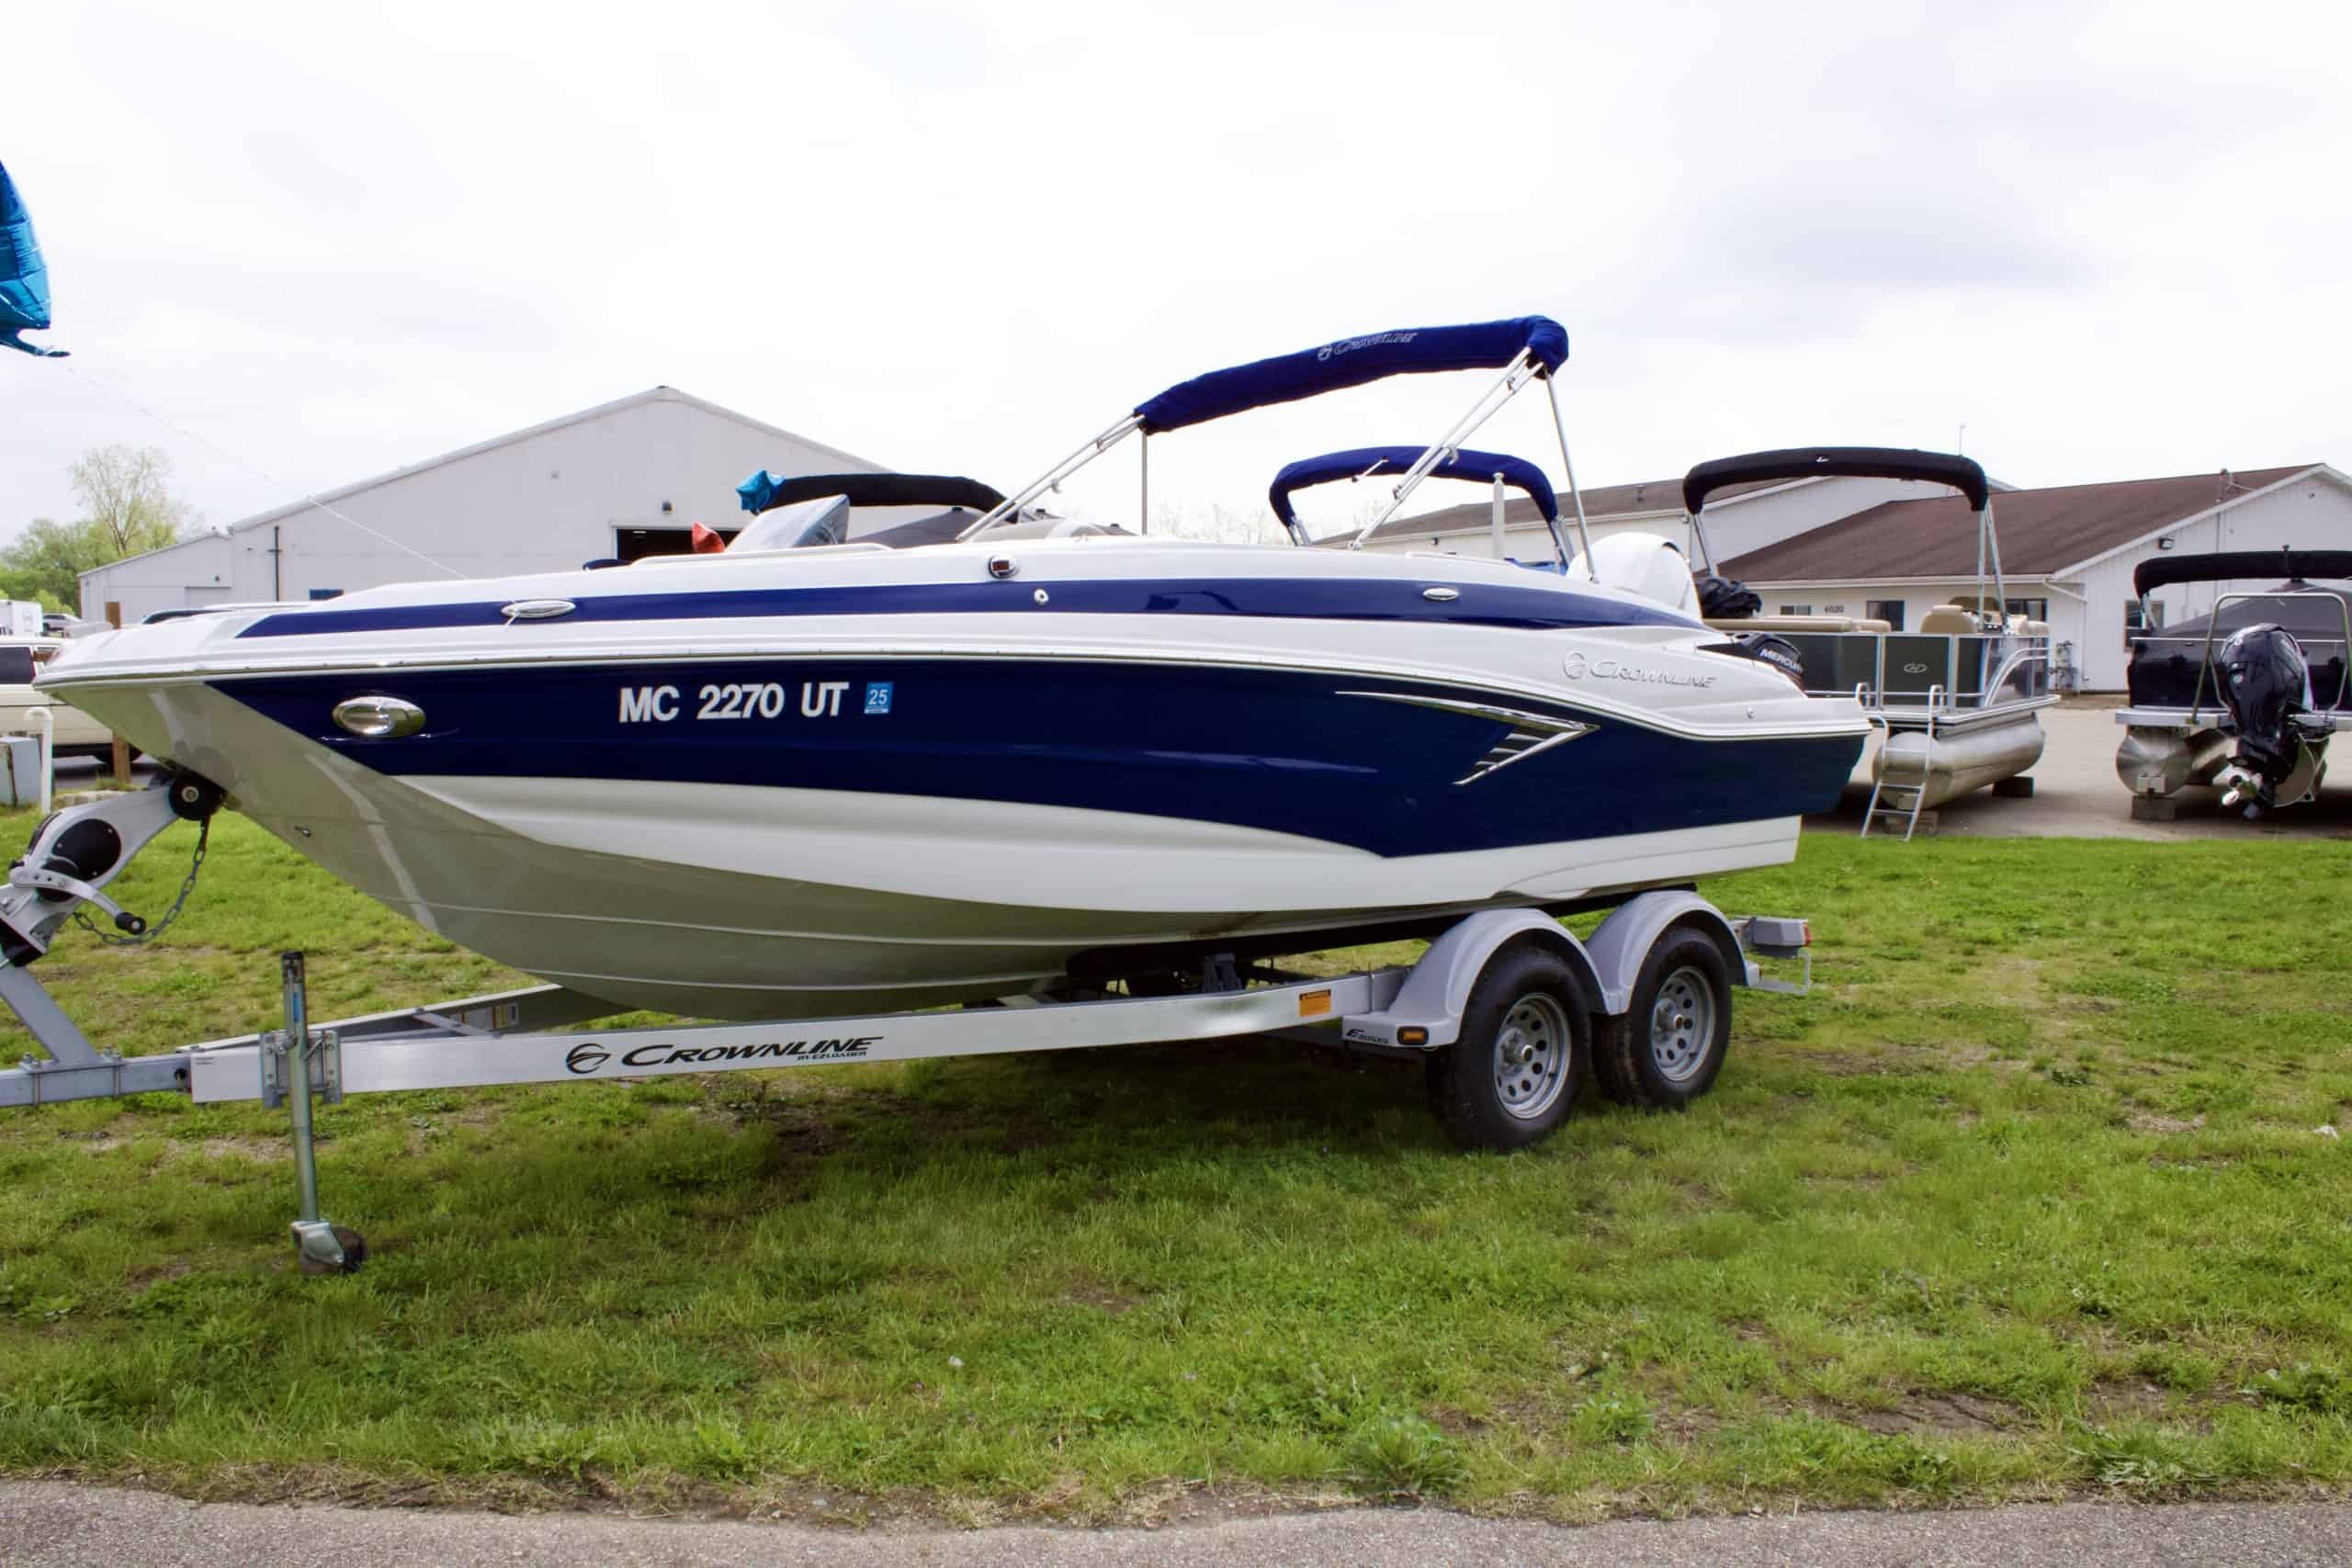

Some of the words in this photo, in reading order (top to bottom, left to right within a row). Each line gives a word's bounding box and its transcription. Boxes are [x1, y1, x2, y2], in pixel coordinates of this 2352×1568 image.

[1590, 660, 1717, 688] CROWNLINE
[618, 685, 680, 723] MC
[696, 682, 786, 720] 2270
[801, 682, 850, 717] UT
[868, 689, 888, 705] 25
[621, 1035, 884, 1067] CROWNLINE
